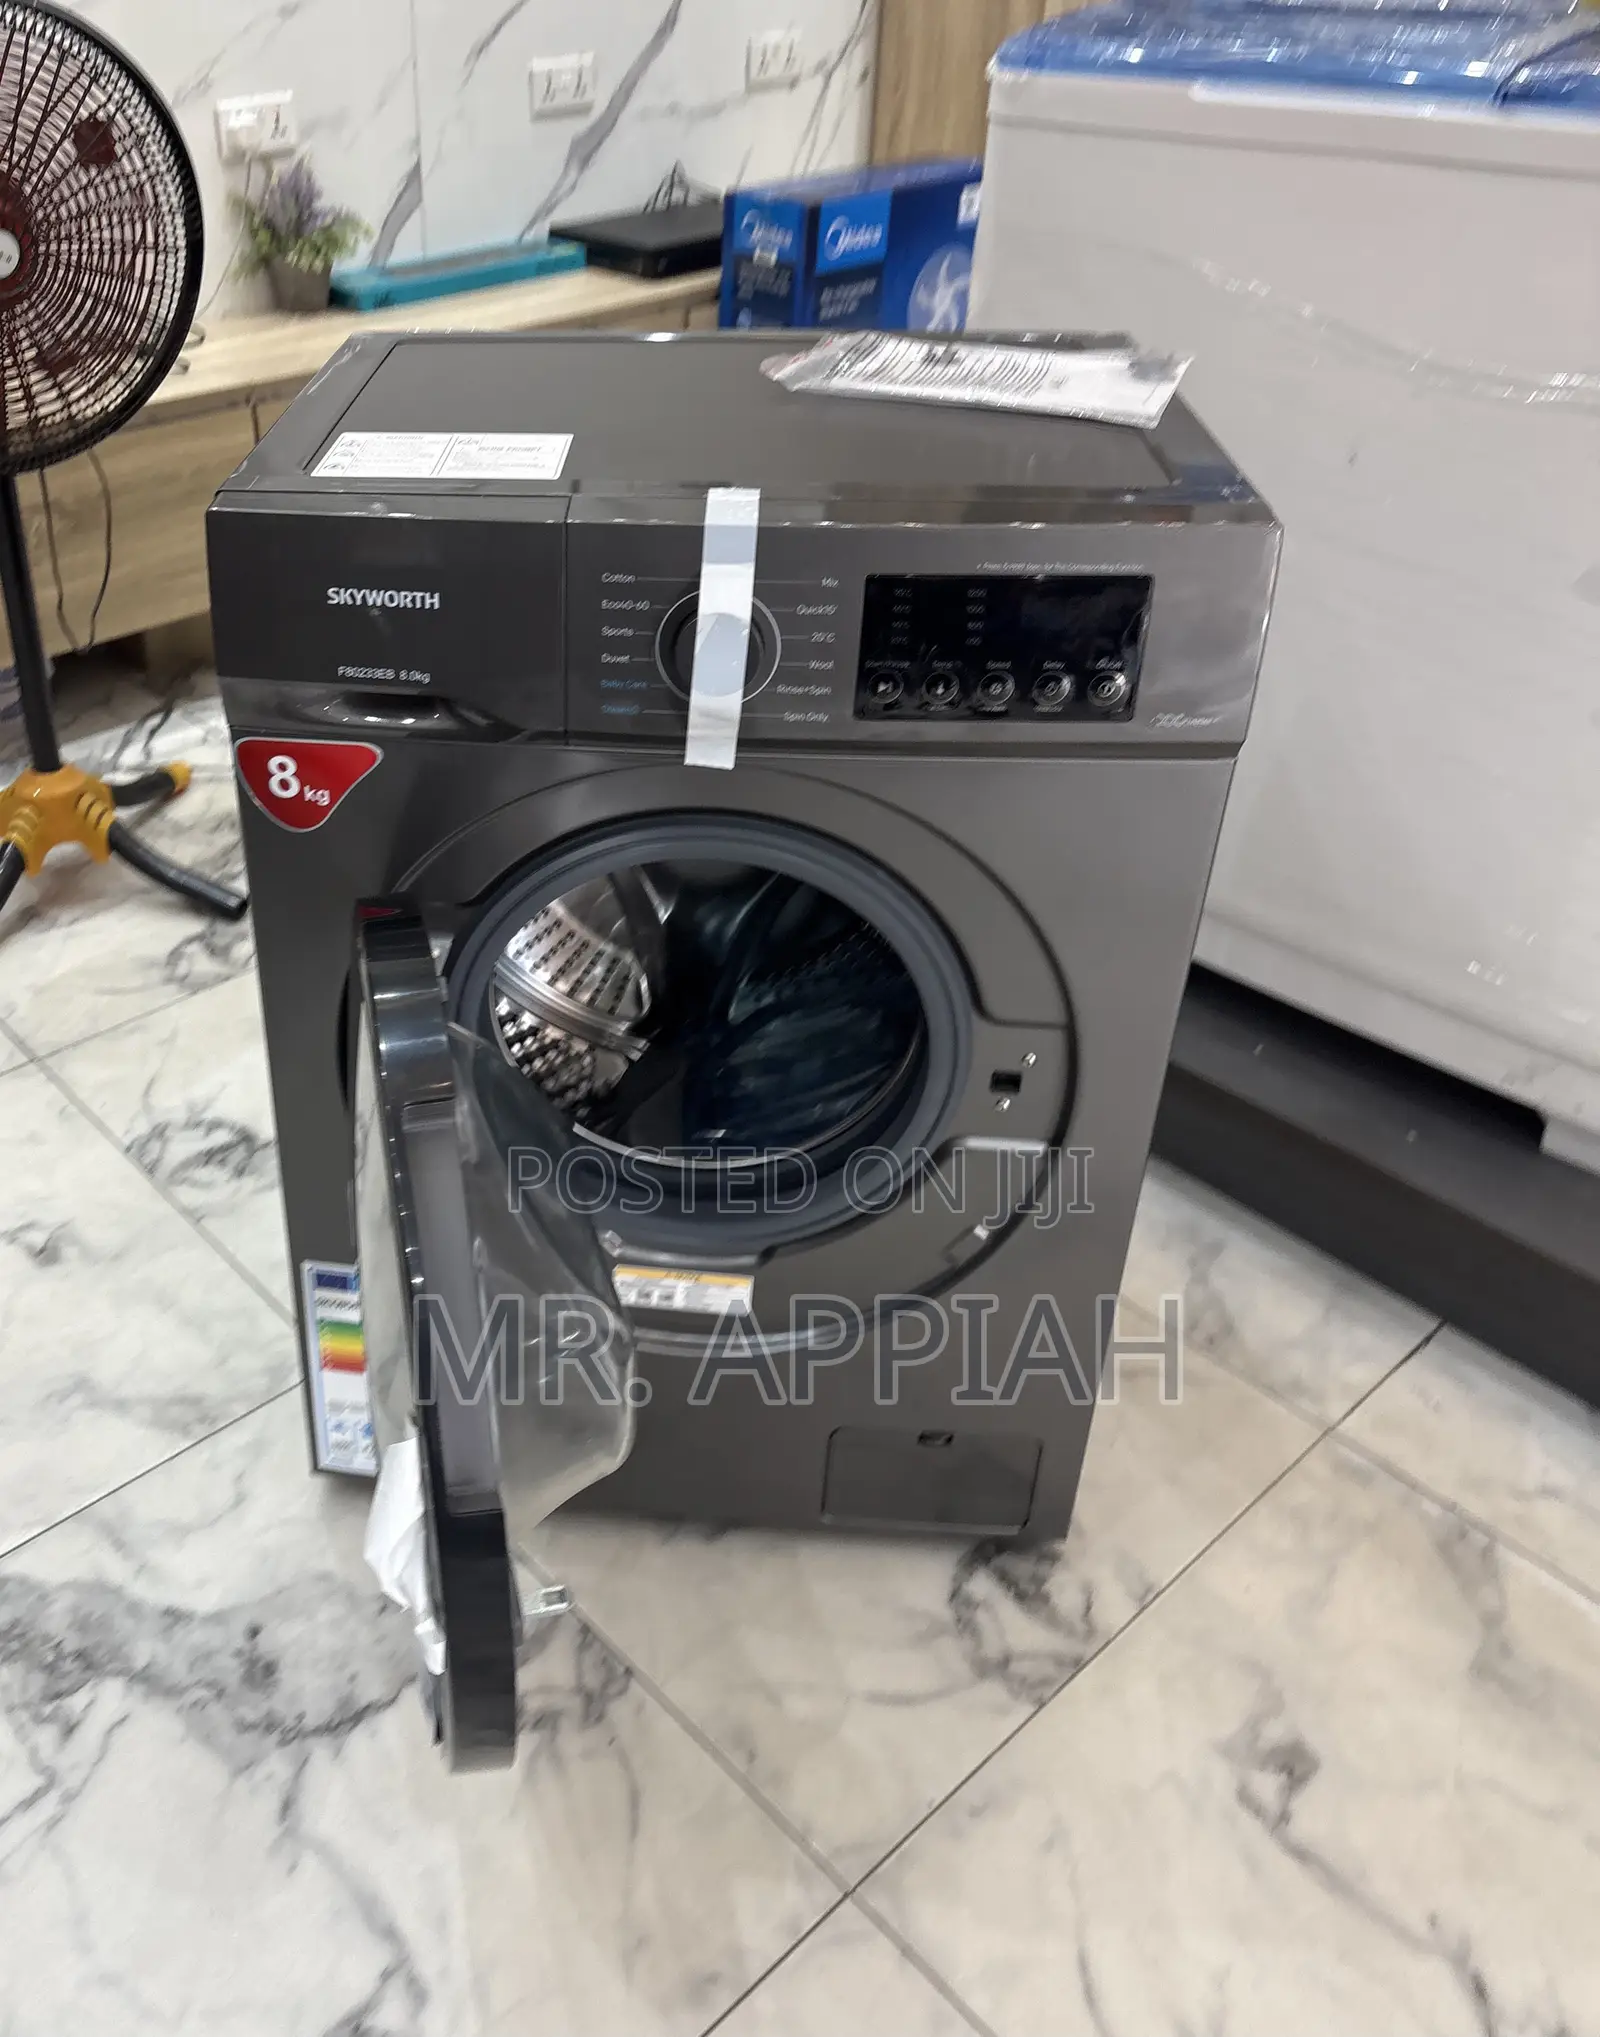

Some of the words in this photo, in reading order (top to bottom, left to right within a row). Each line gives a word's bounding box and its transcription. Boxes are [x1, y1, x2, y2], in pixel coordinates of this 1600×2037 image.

[601, 572, 636, 583] Cotton
[326, 586, 441, 611] SKYWORTH
[267, 754, 301, 799] 8
[303, 784, 331, 807] kg
